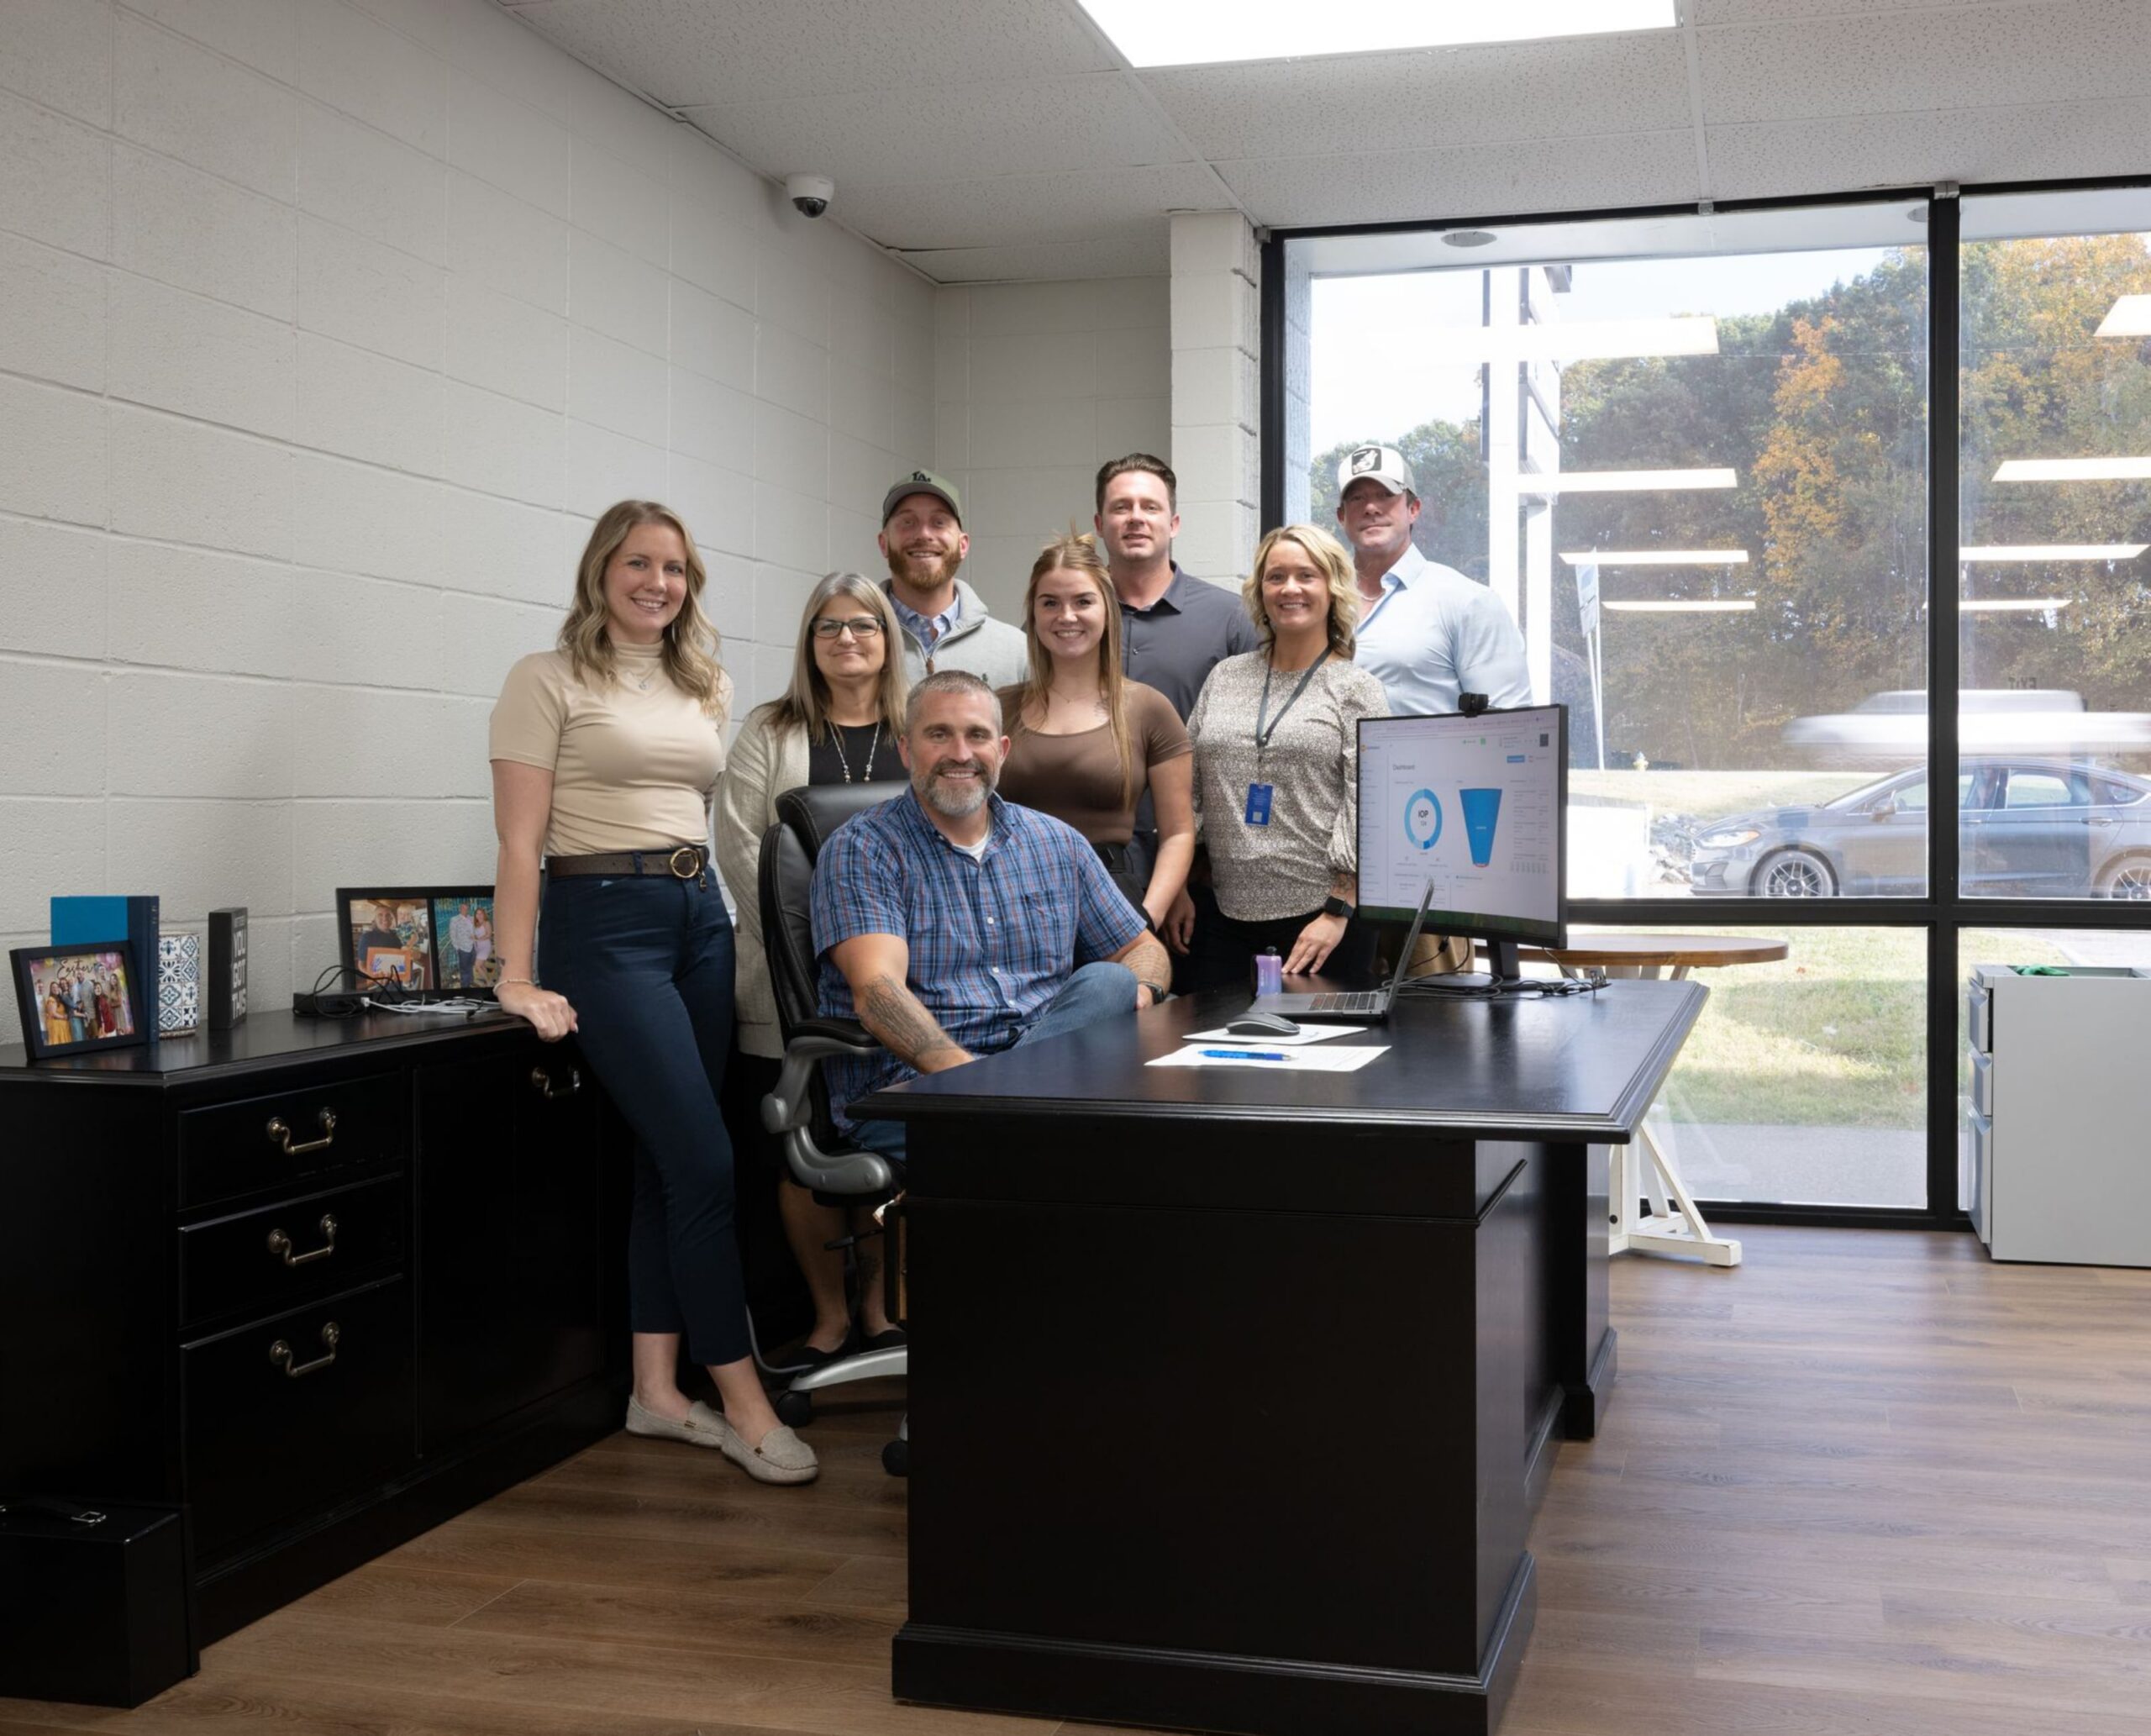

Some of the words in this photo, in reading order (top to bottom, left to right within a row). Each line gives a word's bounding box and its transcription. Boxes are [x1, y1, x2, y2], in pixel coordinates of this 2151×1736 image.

[234, 929, 246, 958] YOU
[233, 960, 246, 988] GOT
[232, 989, 246, 1019] THIS
